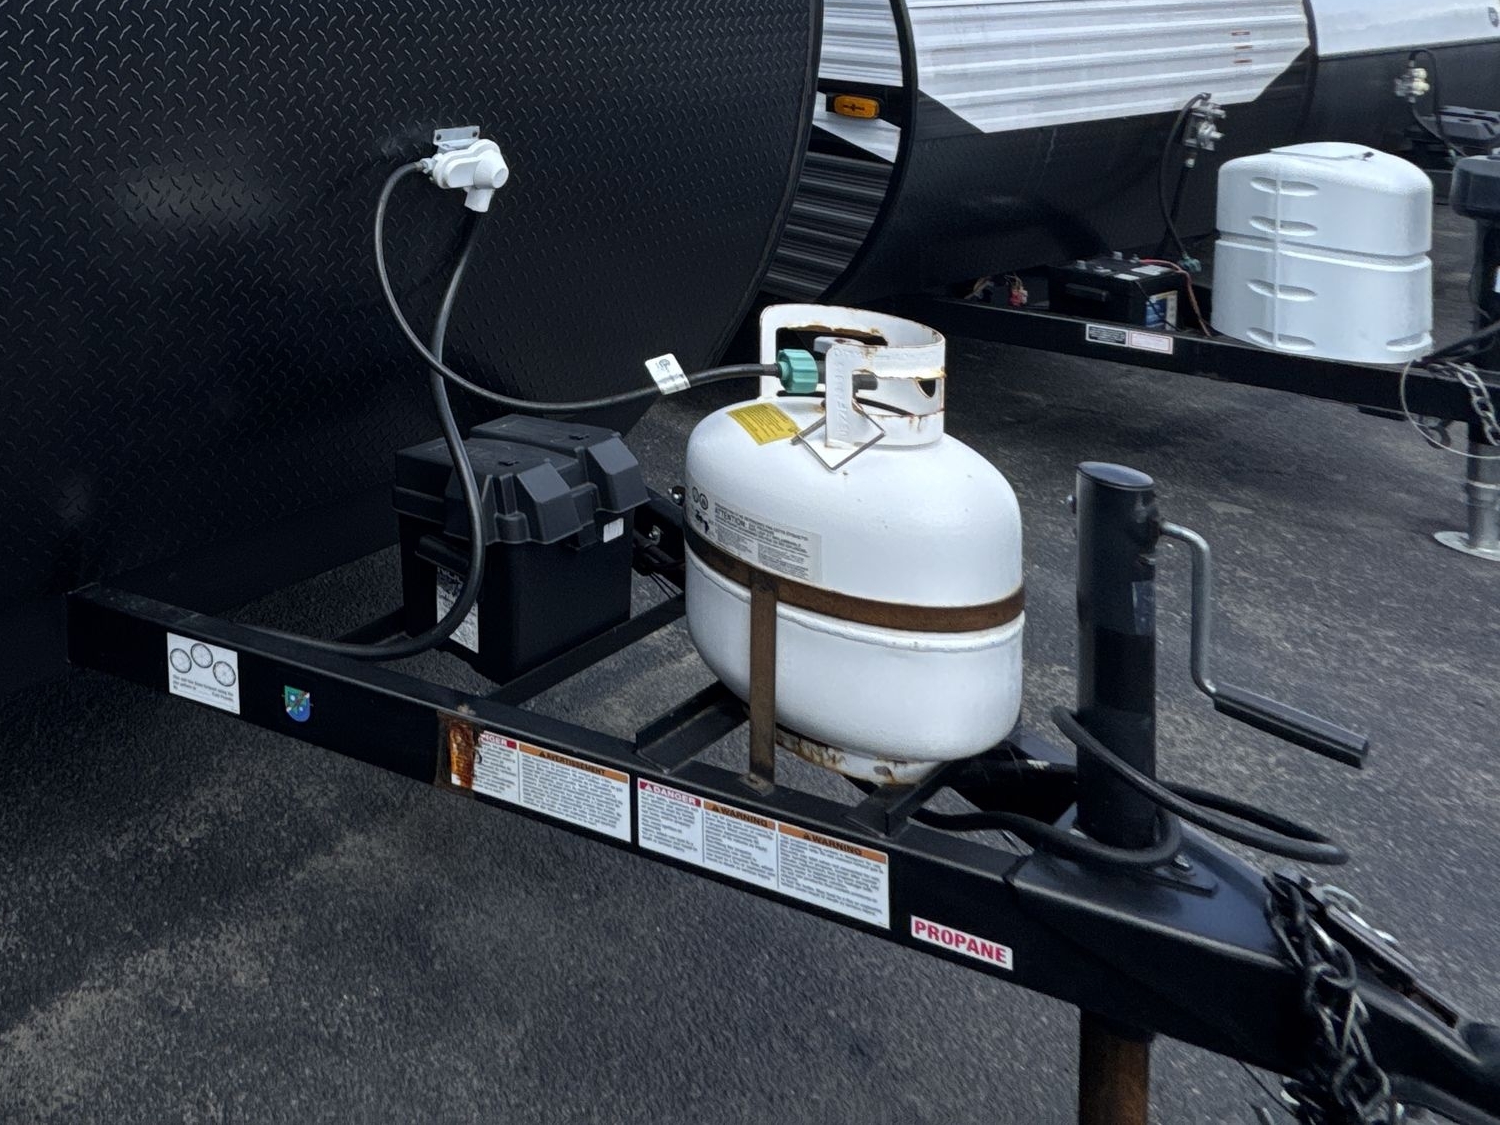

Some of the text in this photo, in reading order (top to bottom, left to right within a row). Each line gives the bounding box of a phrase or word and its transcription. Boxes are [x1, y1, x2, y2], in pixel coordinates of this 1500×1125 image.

[652, 786, 863, 856] DANGER WARNING WARNING
[914, 919, 1007, 965] PROPANE
